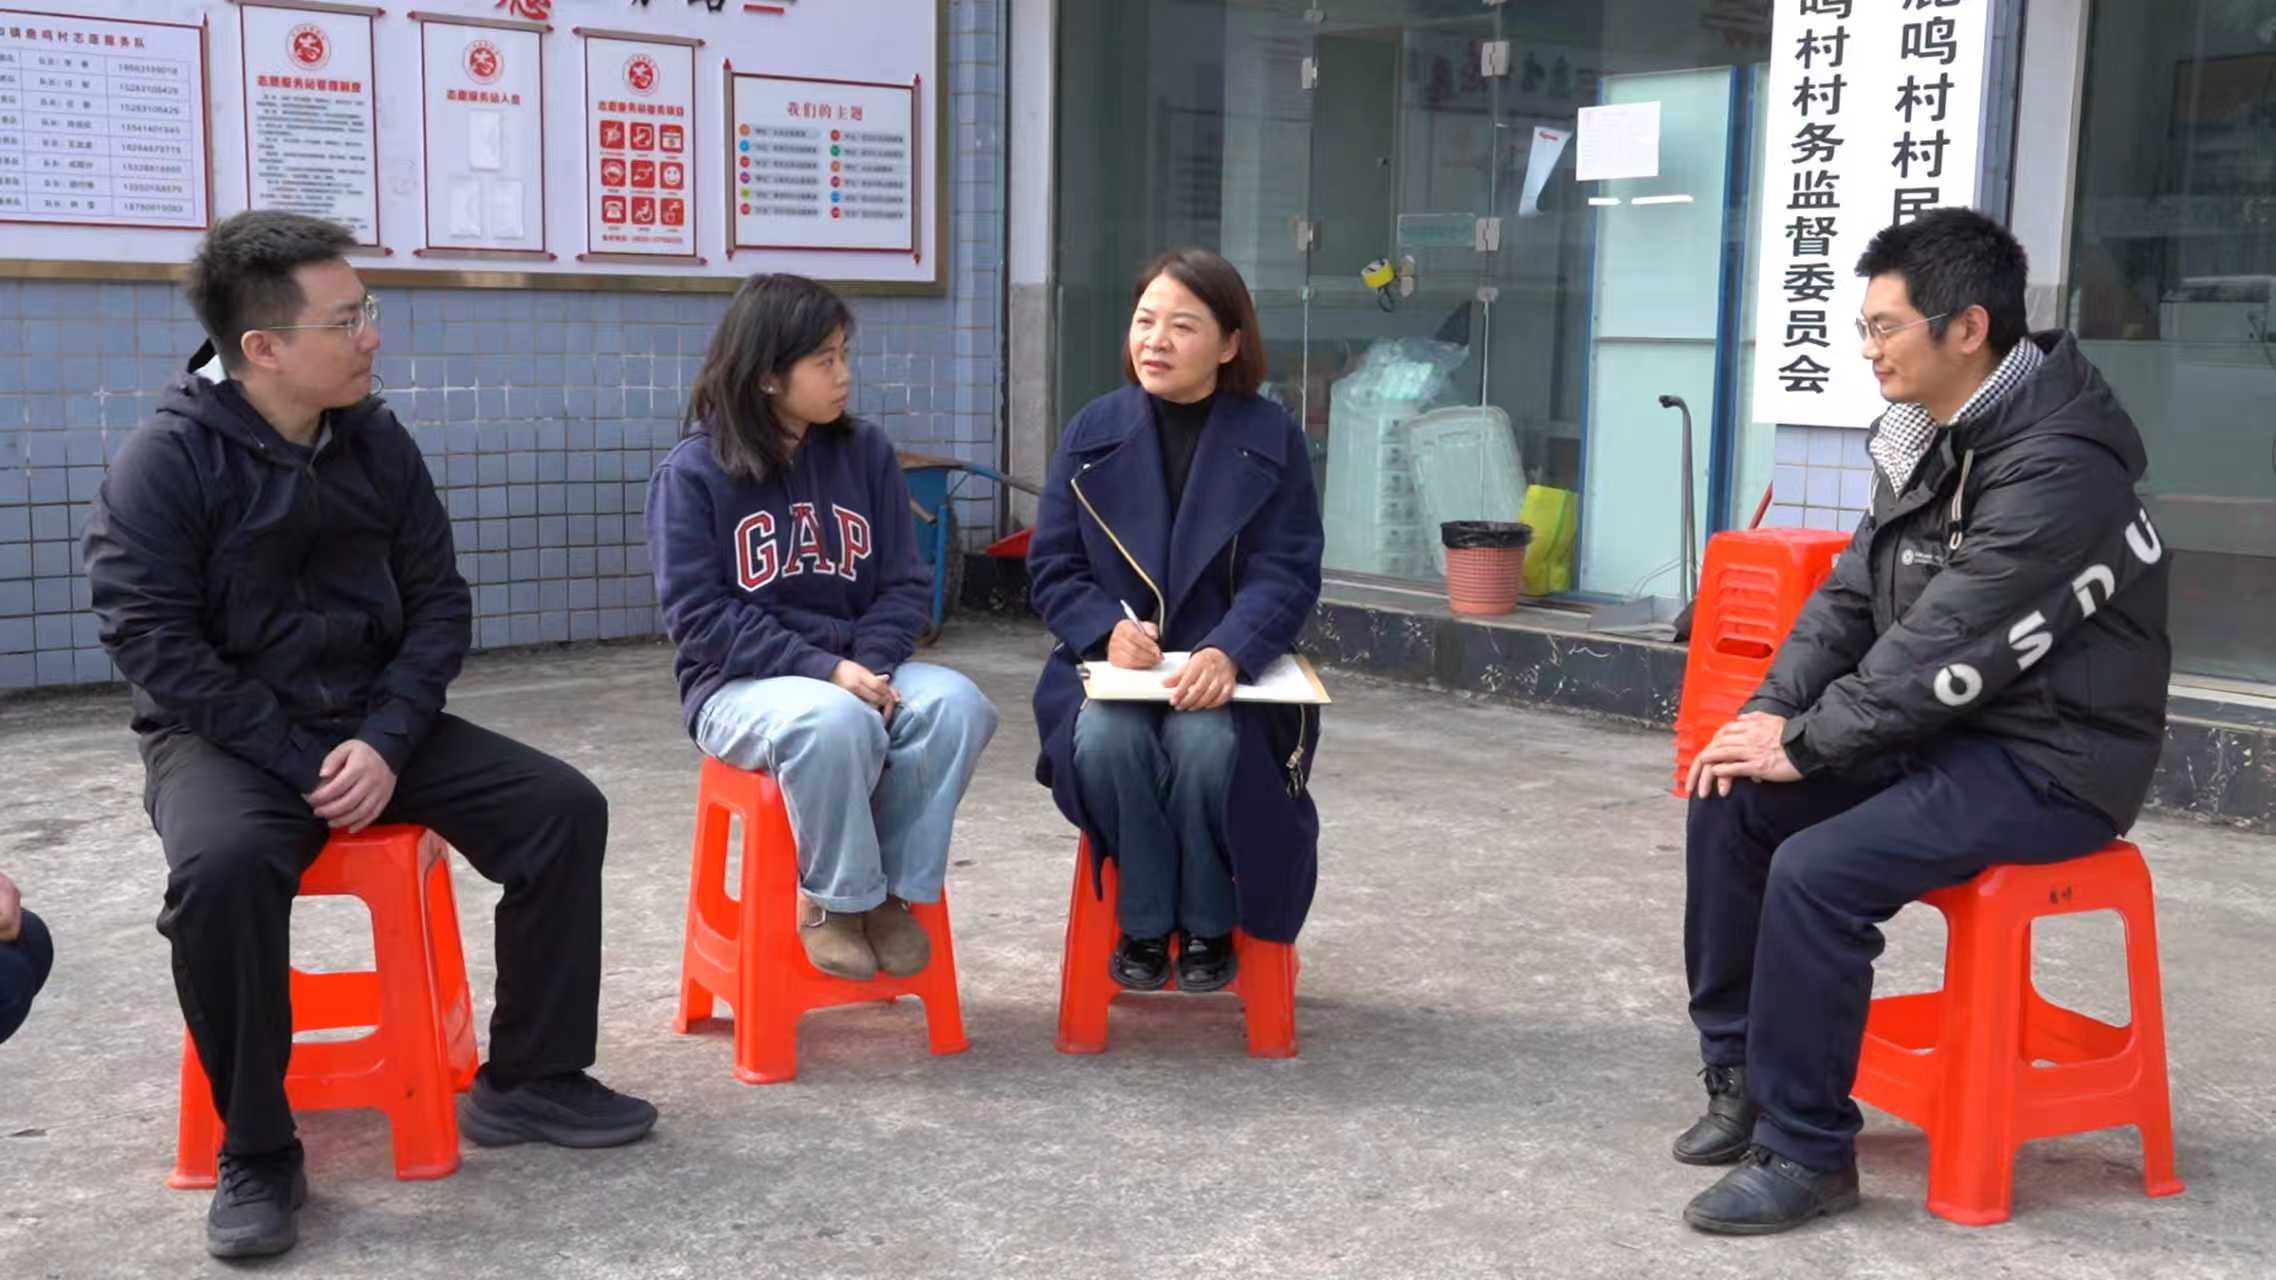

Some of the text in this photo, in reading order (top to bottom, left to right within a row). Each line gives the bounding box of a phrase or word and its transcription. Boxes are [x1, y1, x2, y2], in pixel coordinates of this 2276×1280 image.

[787, 101, 863, 121] 我们的主题
[734, 502, 872, 592] GAP
